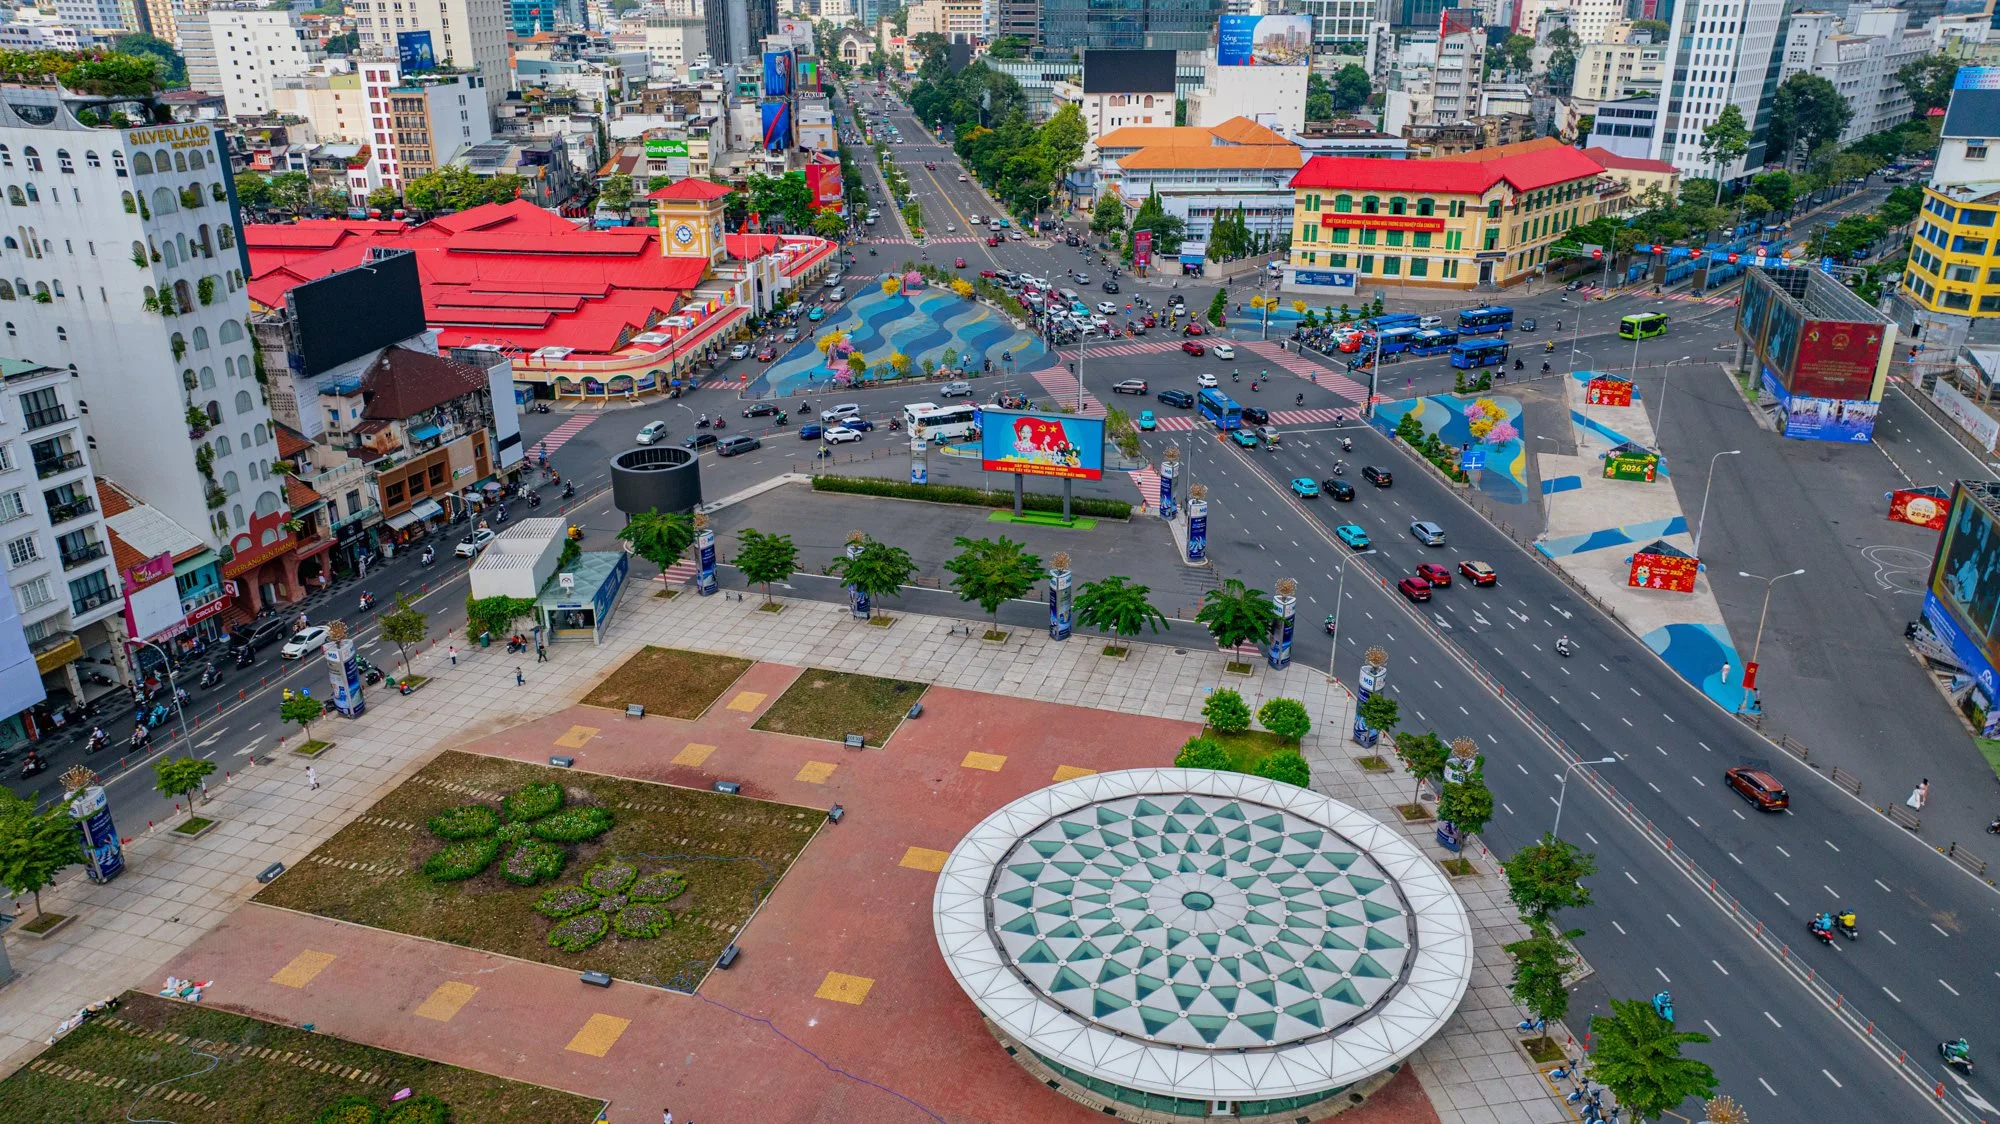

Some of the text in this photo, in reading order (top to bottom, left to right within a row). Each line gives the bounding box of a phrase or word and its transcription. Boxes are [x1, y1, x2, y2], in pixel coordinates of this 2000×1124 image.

[1223, 34, 1237, 42] Sống
[130, 125, 209, 145] SILVERLAND
[171, 139, 210, 150] HOSPITALITY
[225, 556, 262, 578] SILVERLAND
[262, 550, 274, 560] BEN
[196, 606, 214, 619] CIRCLE
[1364, 677, 1372, 686] MB
[96, 793, 105, 806] MB
